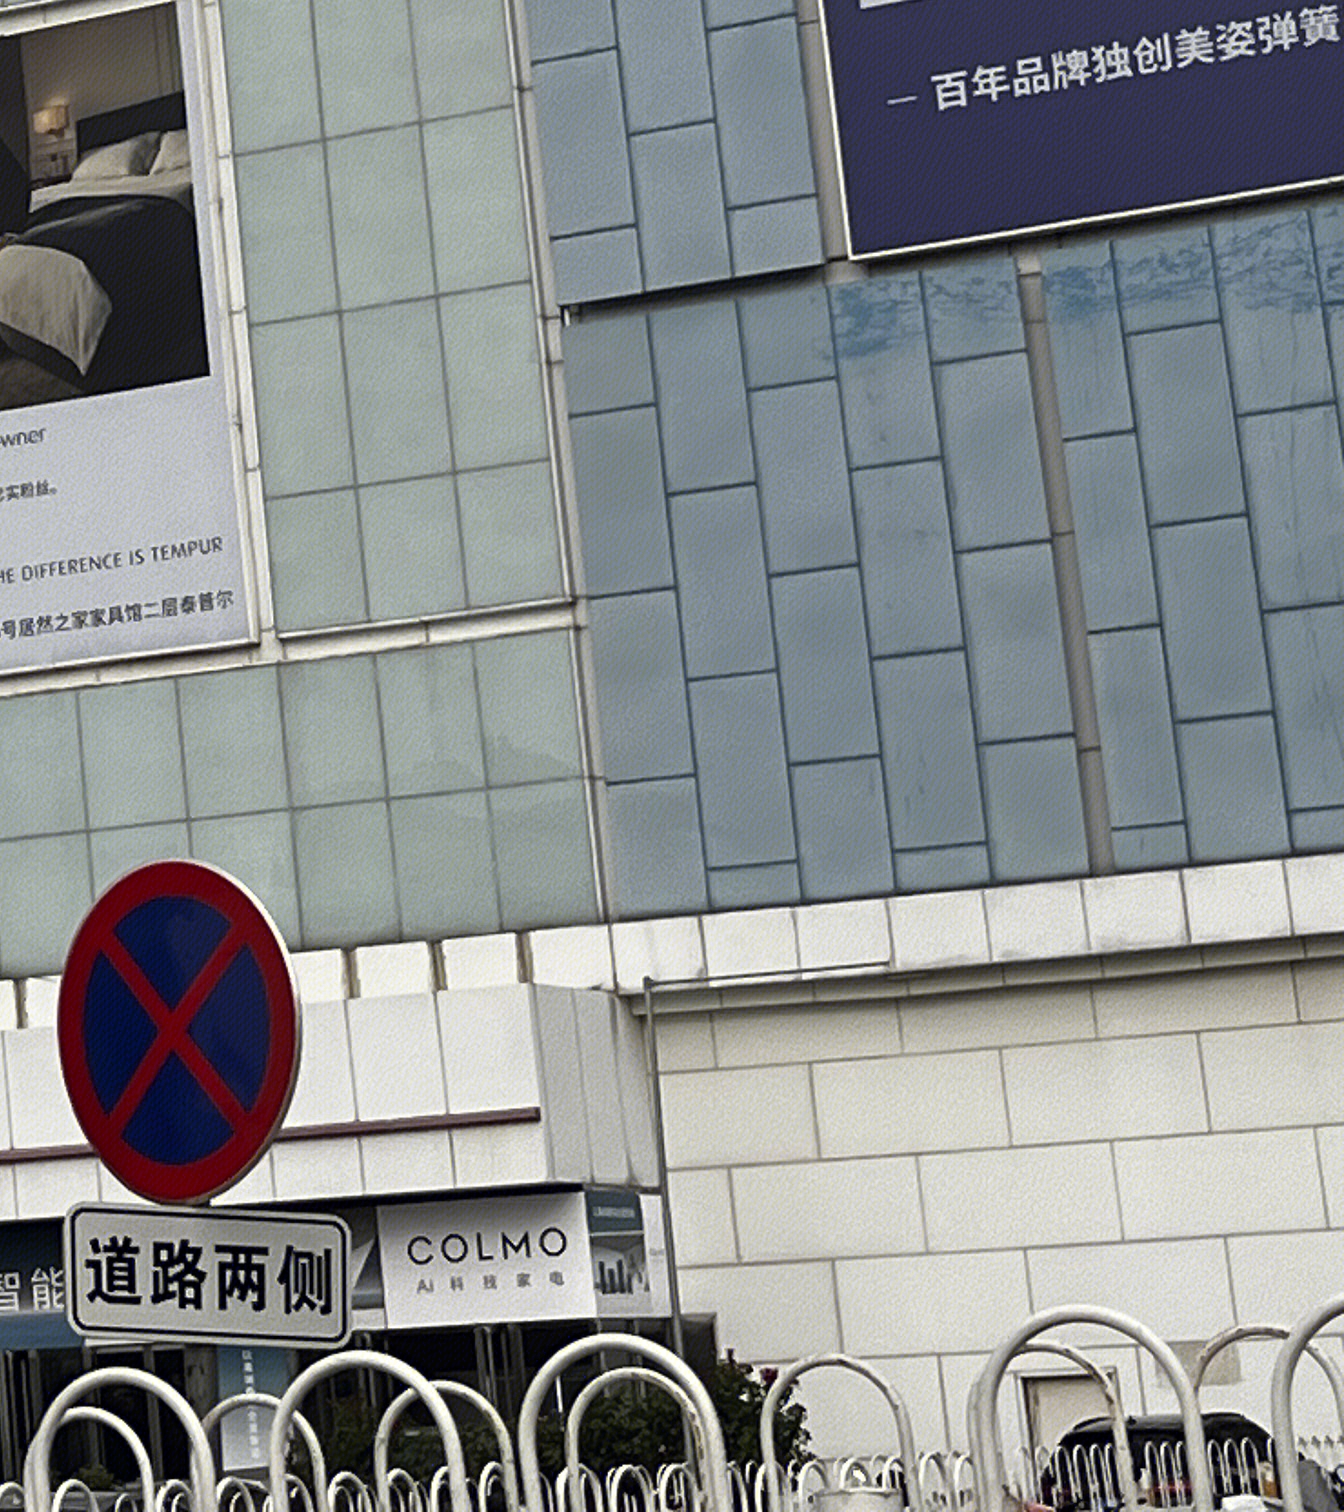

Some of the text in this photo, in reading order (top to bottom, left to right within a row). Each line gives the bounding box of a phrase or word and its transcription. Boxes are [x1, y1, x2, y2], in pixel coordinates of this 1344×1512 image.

[930, 4, 1341, 112] 百年品牌独创美姿弹簧
[21, 551, 123, 582] DIFFERENCE
[129, 548, 146, 566] IS
[151, 536, 223, 562] TEMPUR
[84, 1234, 334, 1317] 道路两侧
[407, 1227, 568, 1266] COLMO
